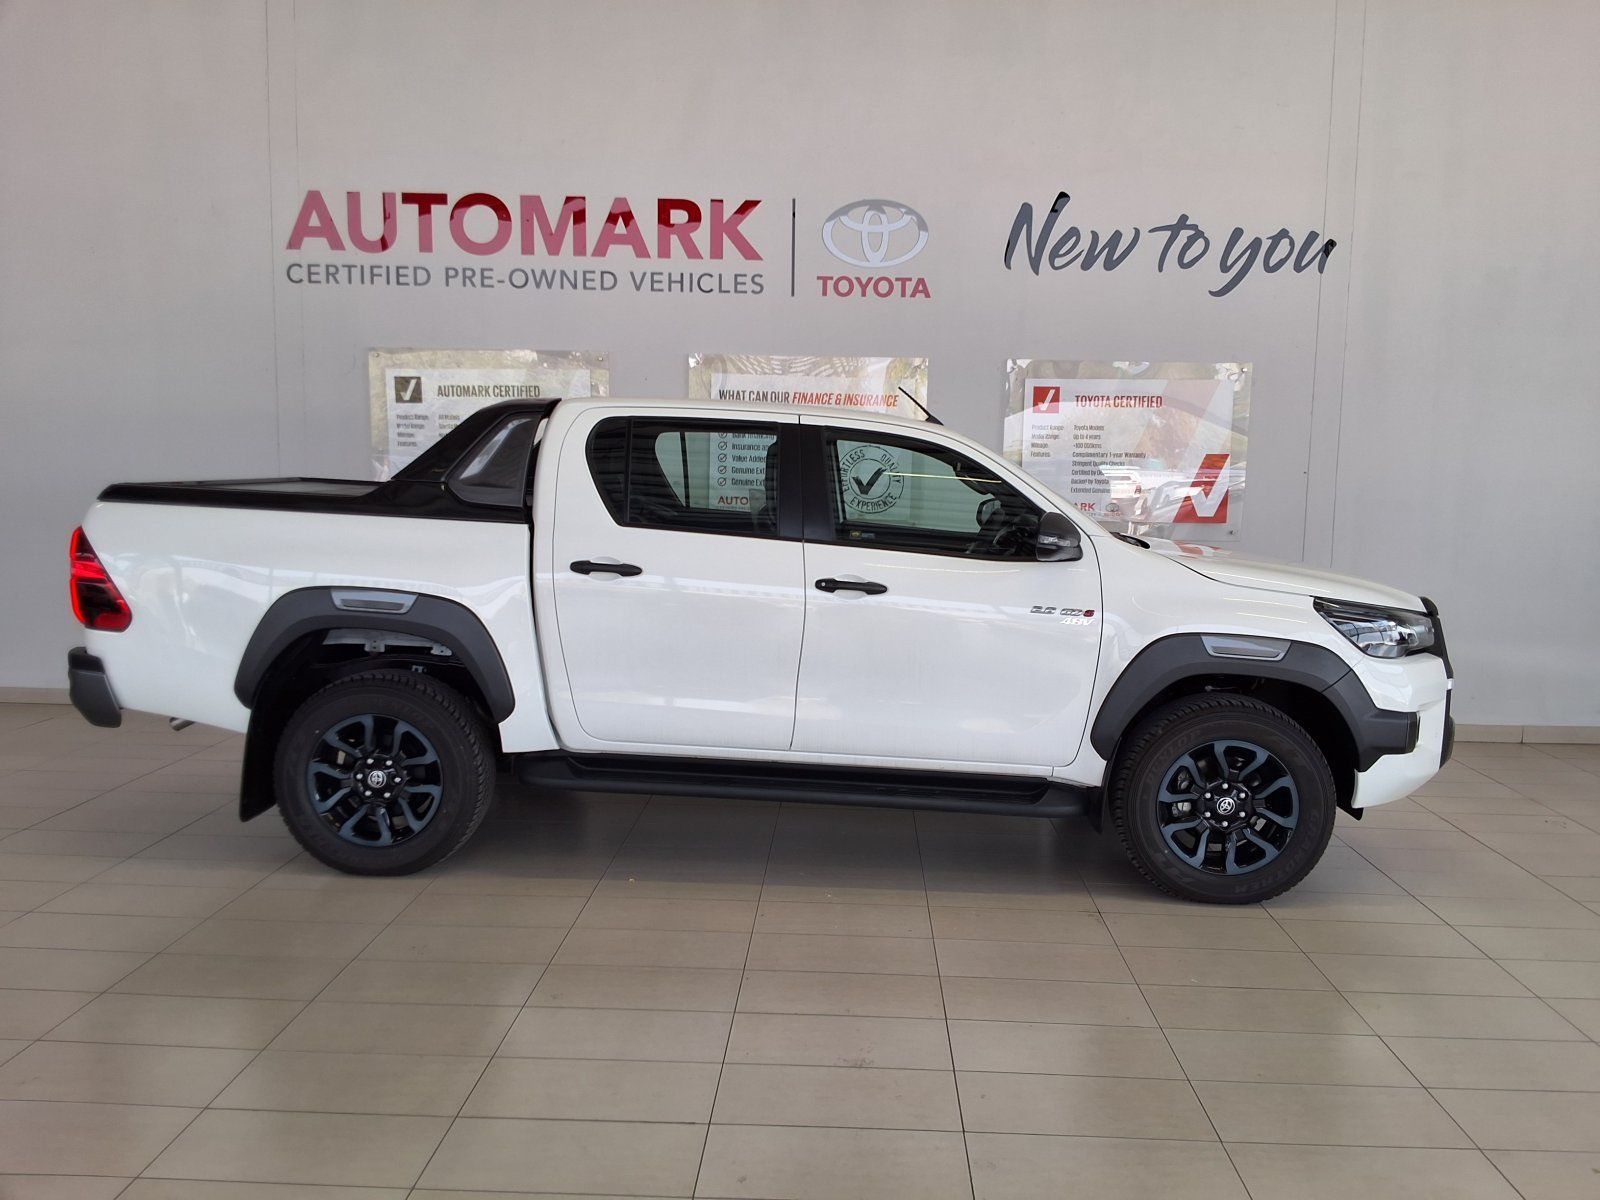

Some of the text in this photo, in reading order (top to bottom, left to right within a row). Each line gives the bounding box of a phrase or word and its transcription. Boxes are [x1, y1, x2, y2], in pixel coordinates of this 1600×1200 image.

[286, 190, 764, 261] AUTOMARK
[1004, 191, 1338, 298] New to you
[286, 263, 765, 295] CERTIFIED PRE-OWNED VEHICLES
[816, 275, 932, 299] TOYOTA
[437, 384, 541, 398] AUTOMARK CERTIFIED
[719, 388, 749, 401] WHAT
[749, 390, 770, 402] CAN
[770, 391, 790, 404] OUR
[792, 391, 833, 406] FINANCE
[843, 393, 899, 408] INSURANCE
[1075, 394, 1163, 409] TOYOTA CERTIFIED
[732, 443, 761, 451] Insurance
[732, 454, 748, 462] Value
[732, 466, 755, 475] Genuine
[732, 478, 755, 486] Genuine
[718, 495, 749, 506] AUTO
[850, 492, 897, 512] EXPERIENCE
